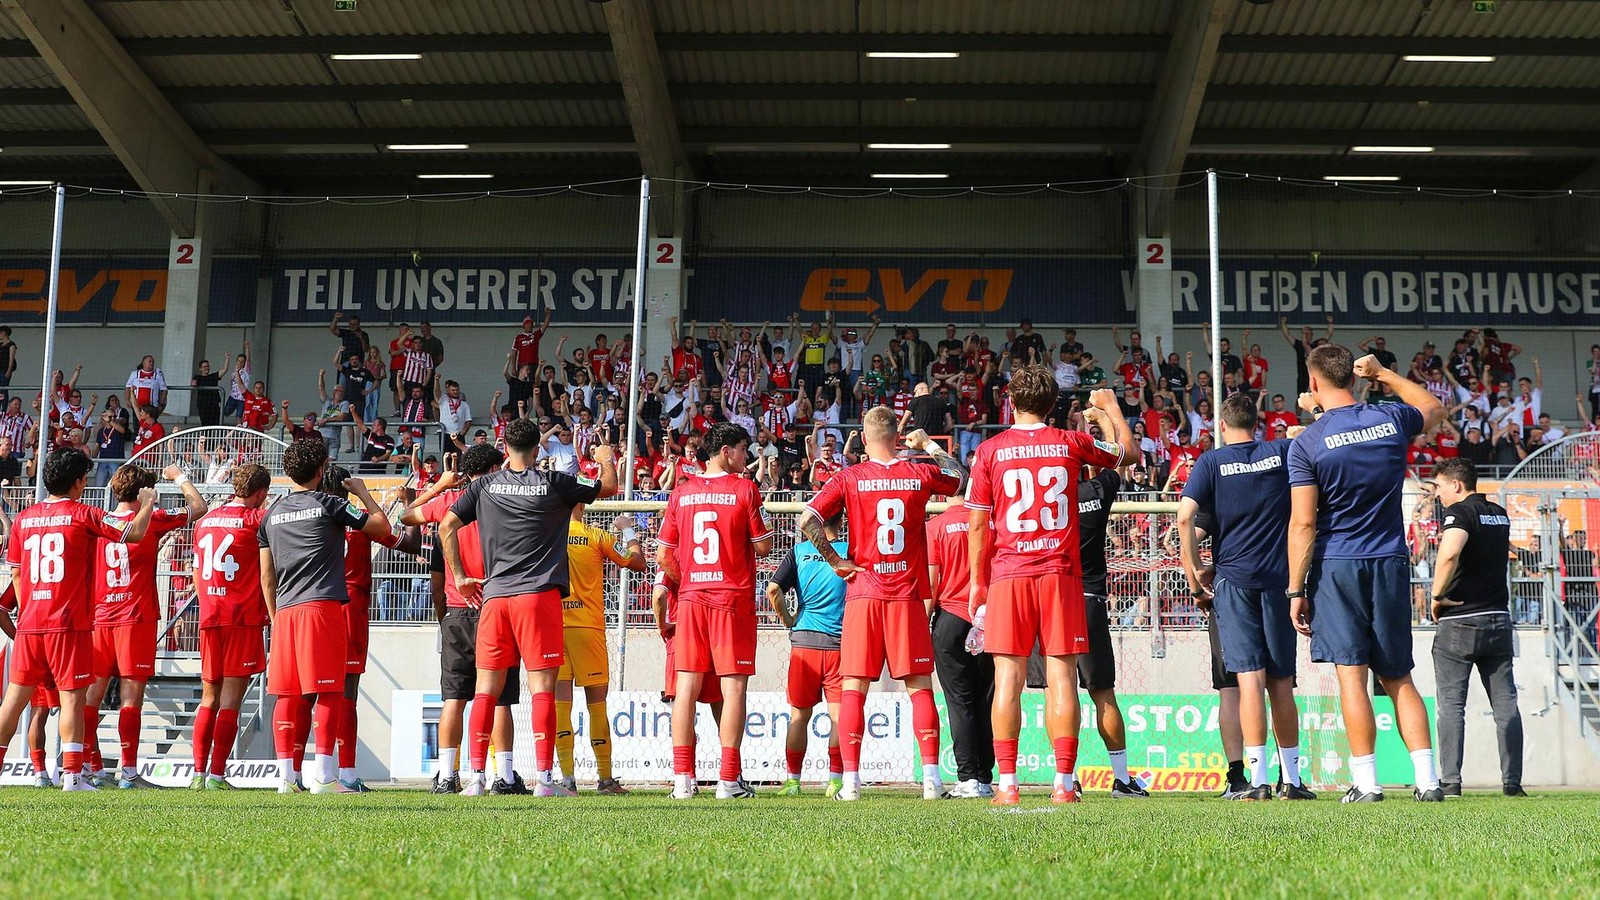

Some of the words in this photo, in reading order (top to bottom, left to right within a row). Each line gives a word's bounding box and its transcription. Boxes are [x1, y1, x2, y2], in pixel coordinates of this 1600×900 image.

[176, 244, 194, 264] 2
[656, 243, 675, 264] 2
[1146, 243, 1164, 264] 2
[0, 269, 169, 316] evo
[285, 269, 362, 311] TEIL
[375, 268, 557, 311] UNSERER
[571, 268, 695, 311] STAT
[799, 268, 1015, 315] evo
[1324, 422, 1398, 450] OBERHAUSEN
[996, 444, 1069, 462] OBERHAUSEN
[1219, 455, 1283, 477] OBERHAUSEN
[489, 484, 548, 497] OBERHAUSEN
[858, 478, 922, 492] OBERHAUSEN
[679, 493, 737, 506] OBERHAUSEN
[1002, 466, 1069, 533] 23
[1078, 498, 1102, 514] USEN
[271, 508, 323, 526] OBERHAUSEN
[876, 498, 905, 556] 8
[568, 536, 589, 546] USEN
[693, 511, 720, 565] 5
[24, 532, 65, 585] 18
[105, 542, 131, 588] 9
[198, 533, 240, 582] 14
[690, 571, 723, 582] MURRAY
[1128, 704, 1220, 733] STOA
[743, 758, 757, 769] 12
[1151, 771, 1222, 791] LOTTO
